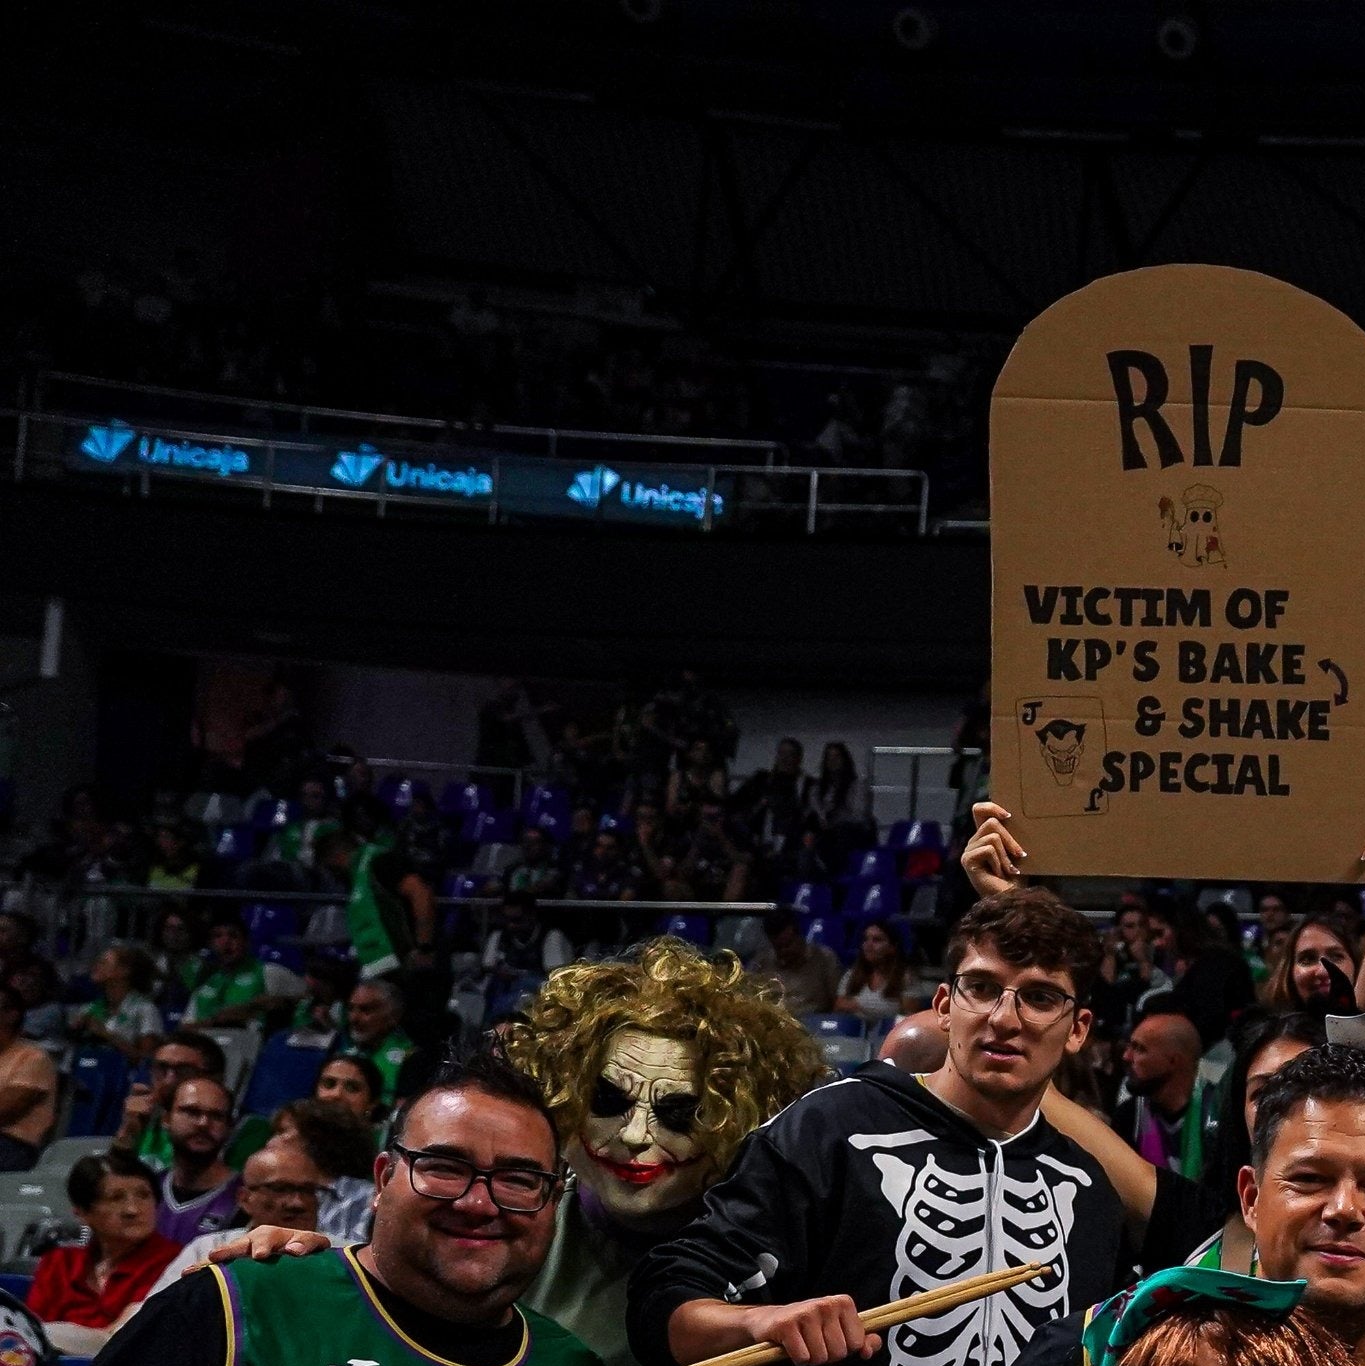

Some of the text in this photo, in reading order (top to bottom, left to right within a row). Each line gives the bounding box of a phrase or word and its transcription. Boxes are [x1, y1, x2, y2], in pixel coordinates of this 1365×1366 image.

[1106, 344, 1285, 471] RIP
[138, 434, 251, 477] Unicaja
[385, 460, 493, 497] Unicaja
[1023, 584, 1290, 630] VICTIM OF
[1046, 637, 1306, 686] KP'S BAKE
[1135, 696, 1331, 742] & SHAKE
[1101, 750, 1290, 797] SPECIAL
